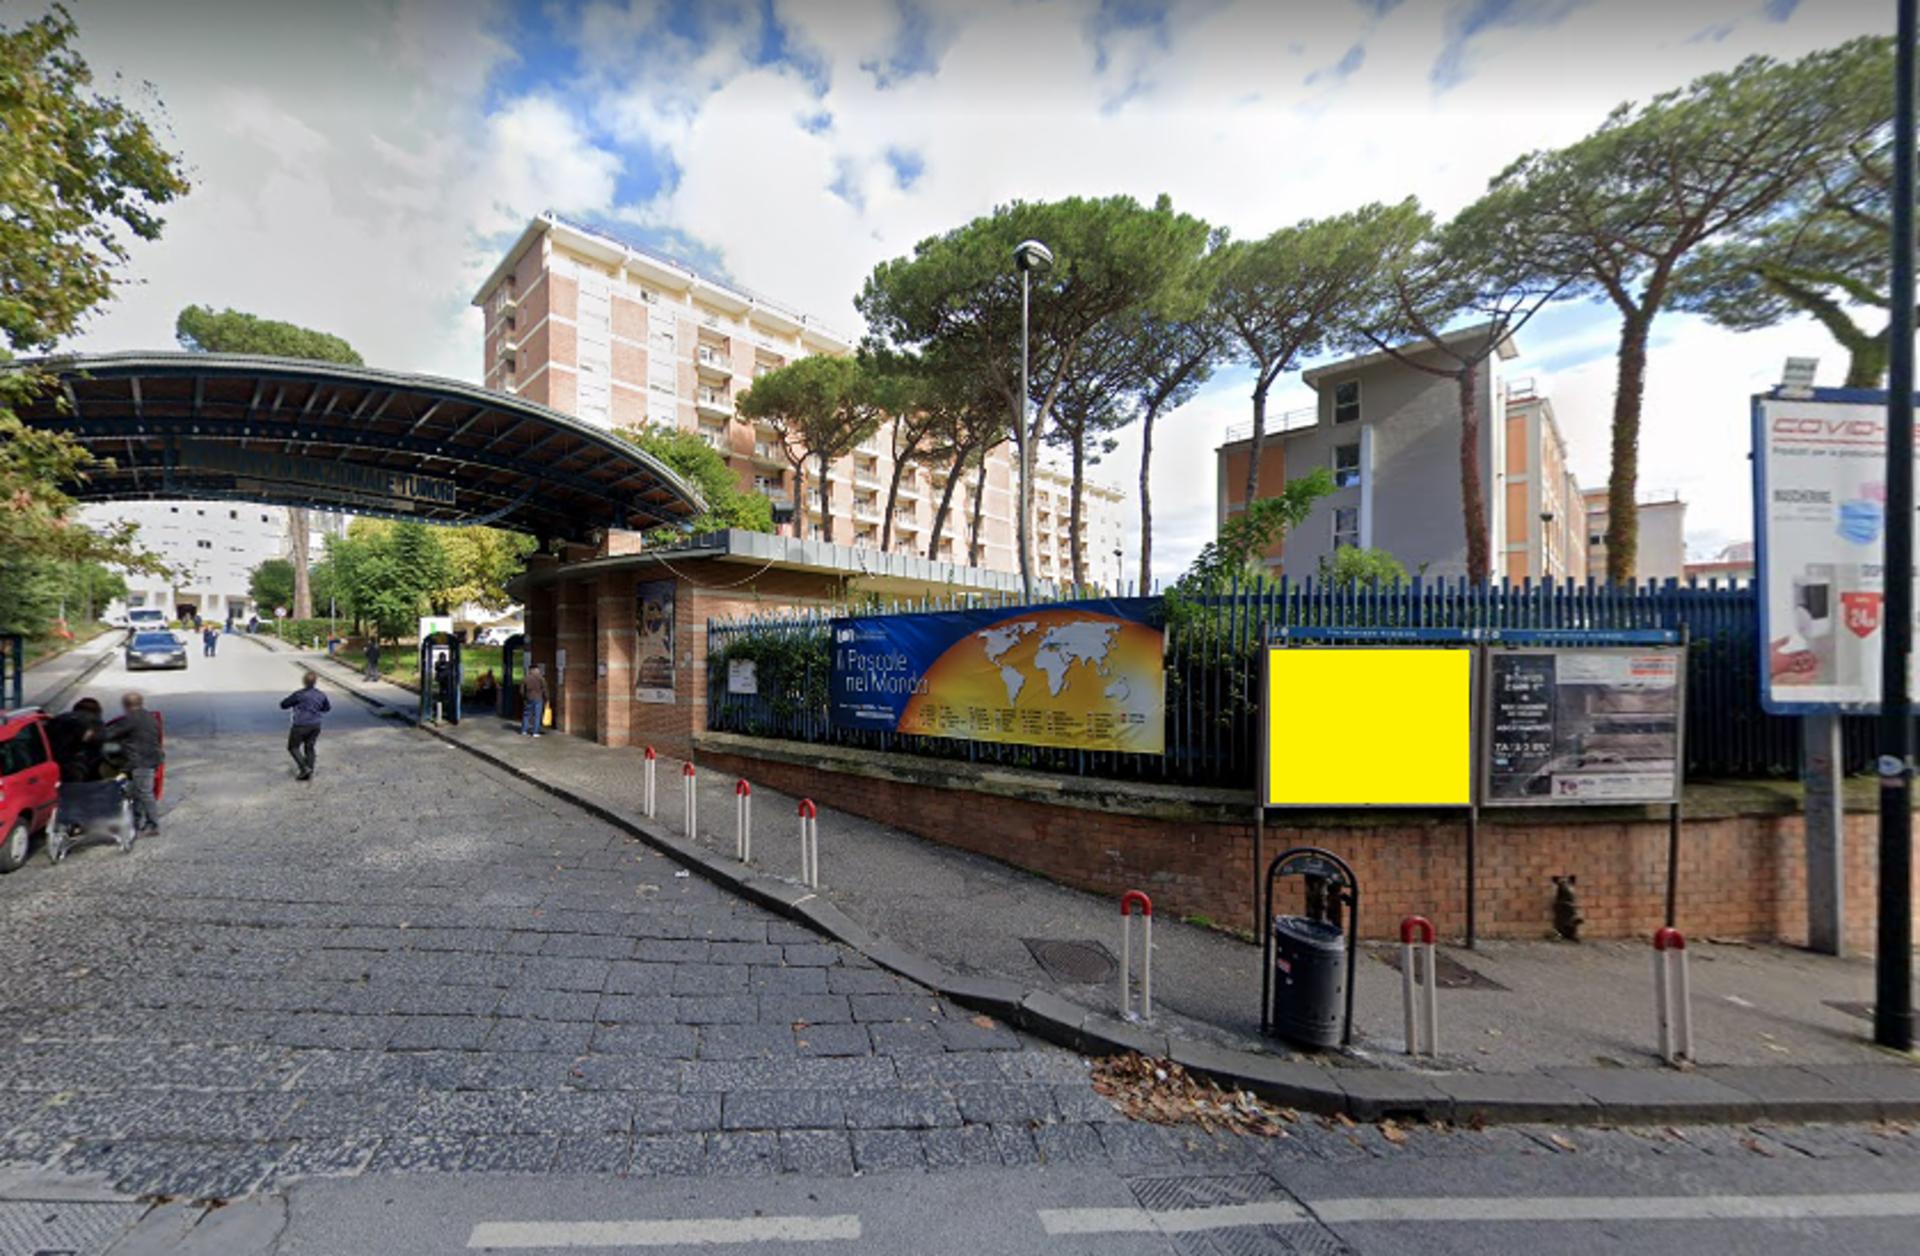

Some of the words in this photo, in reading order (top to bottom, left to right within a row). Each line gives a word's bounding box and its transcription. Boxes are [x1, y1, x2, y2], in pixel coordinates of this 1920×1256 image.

[1773, 418, 1920, 437] COVID-
[848, 648, 907, 671] Pascale
[846, 670, 868, 692] nel
[871, 670, 929, 694] Mondo
